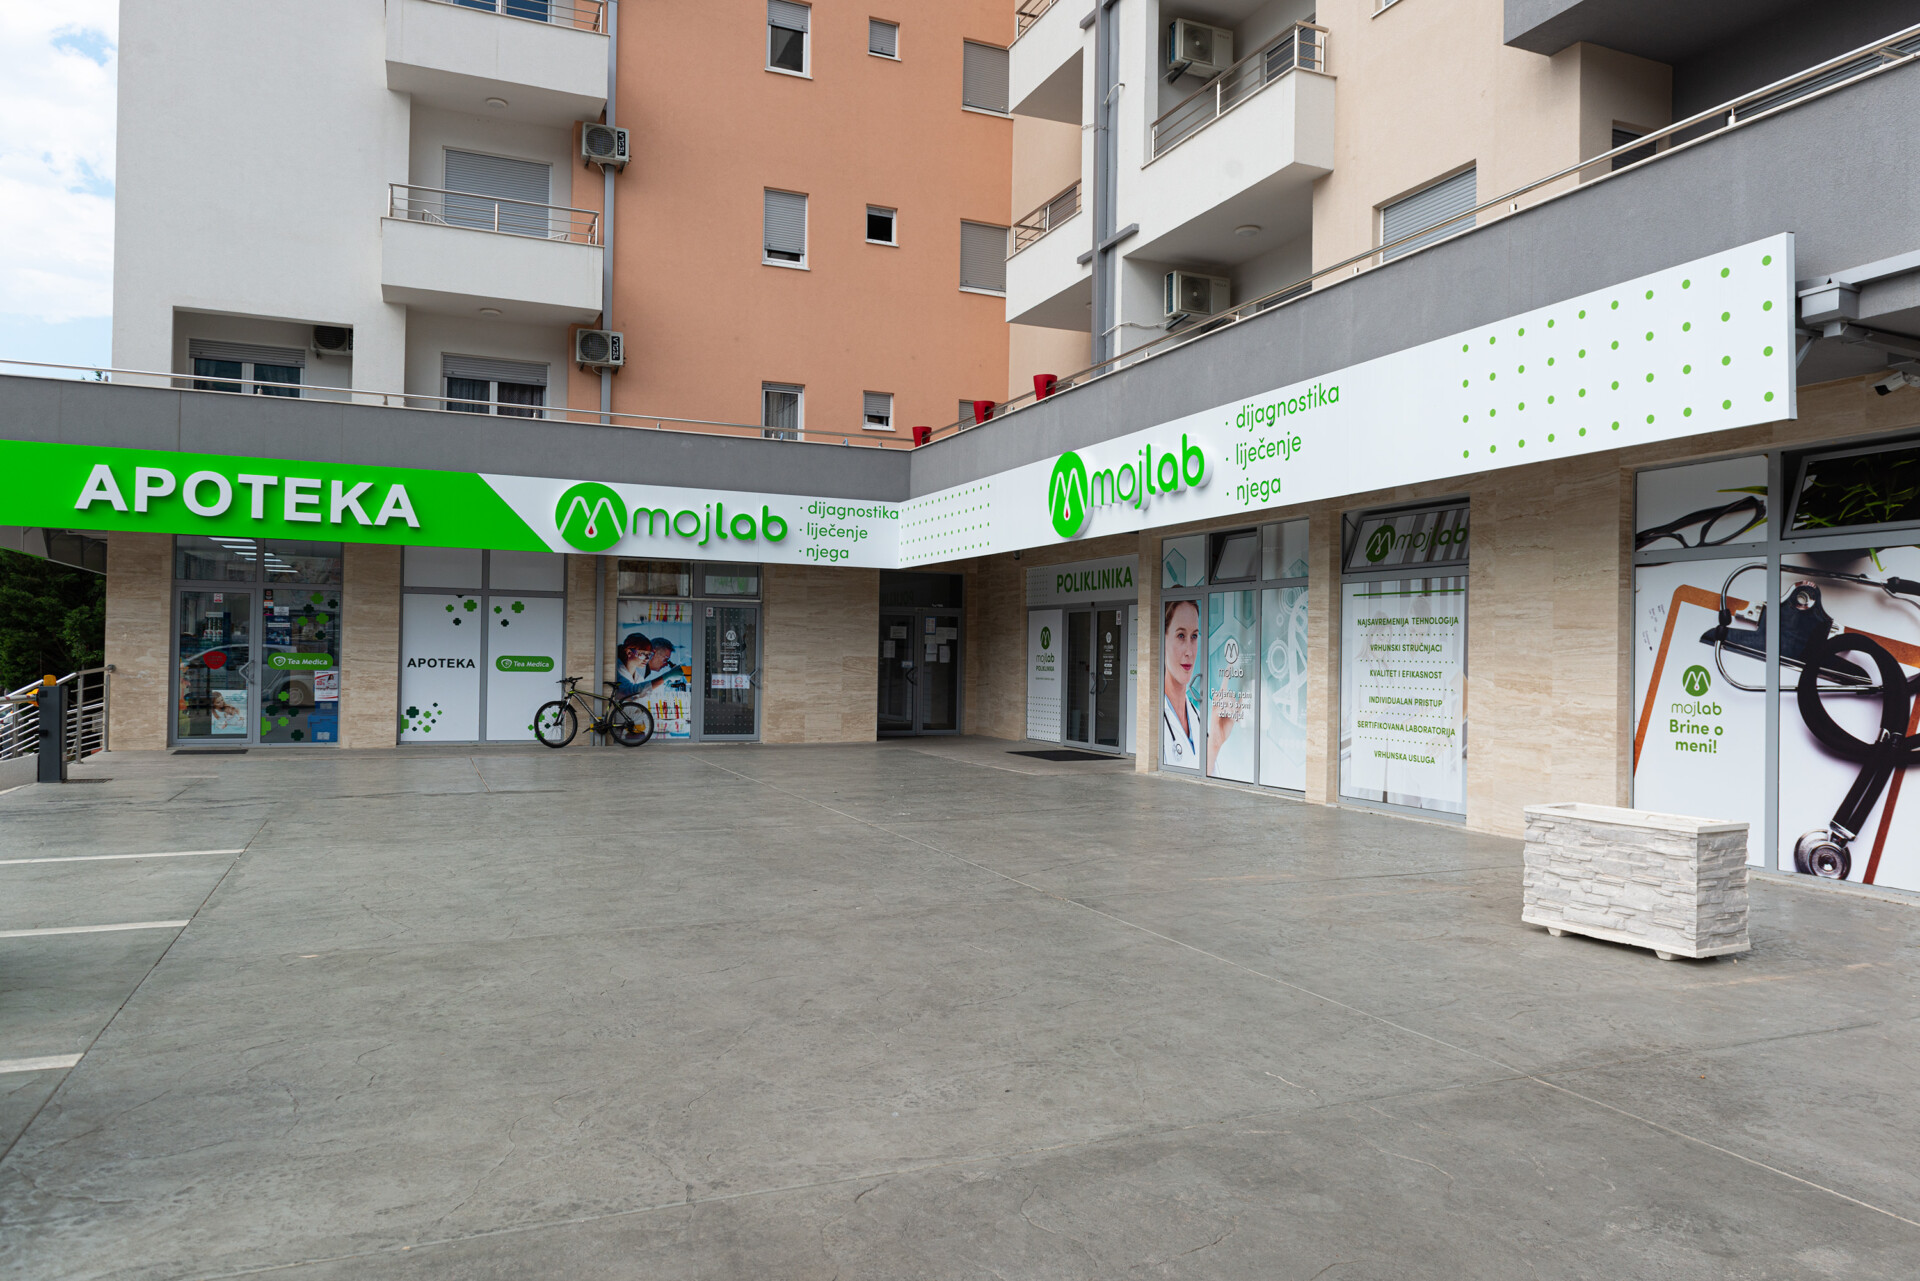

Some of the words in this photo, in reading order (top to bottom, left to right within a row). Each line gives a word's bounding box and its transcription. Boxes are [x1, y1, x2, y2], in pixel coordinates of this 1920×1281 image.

[1236, 382, 1340, 432] dijagnostika
[1235, 431, 1302, 470] liječenje
[1091, 433, 1205, 510] mojlab
[74, 463, 420, 528] APOTEKA
[1236, 475, 1281, 506] njega
[807, 500, 900, 521] dijagnostika
[632, 501, 788, 547] mojlab
[806, 522, 869, 541] liječenje
[1394, 522, 1468, 553] mojlab
[805, 545, 850, 562] njega
[1056, 566, 1133, 594] POLIKLINIKA
[1357, 617, 1409, 628] NAJSAVREMENIJA
[1411, 616, 1459, 627] TEHNOLOGIJA
[1370, 643, 1401, 652] VRHUNSKI
[1402, 642, 1443, 655] STRUČNJACI
[407, 657, 475, 668] APOTEKA
[1369, 669, 1397, 678] KVALITET
[1402, 670, 1442, 680] EFIKASNOST
[1368, 696, 1413, 706] INDIVIDUALAN
[1414, 698, 1442, 708] PRISTUP
[1671, 701, 1722, 717] mojlab
[1357, 721, 1404, 731] SERTIFIKOVANA
[1405, 725, 1456, 738] LABORATORIJA
[1669, 719, 1709, 735] Brine
[1714, 726, 1723, 736] o
[1675, 739, 1717, 753] meni!
[1374, 751, 1407, 761] VRHUNSKA
[1408, 753, 1435, 764] USLUGA
